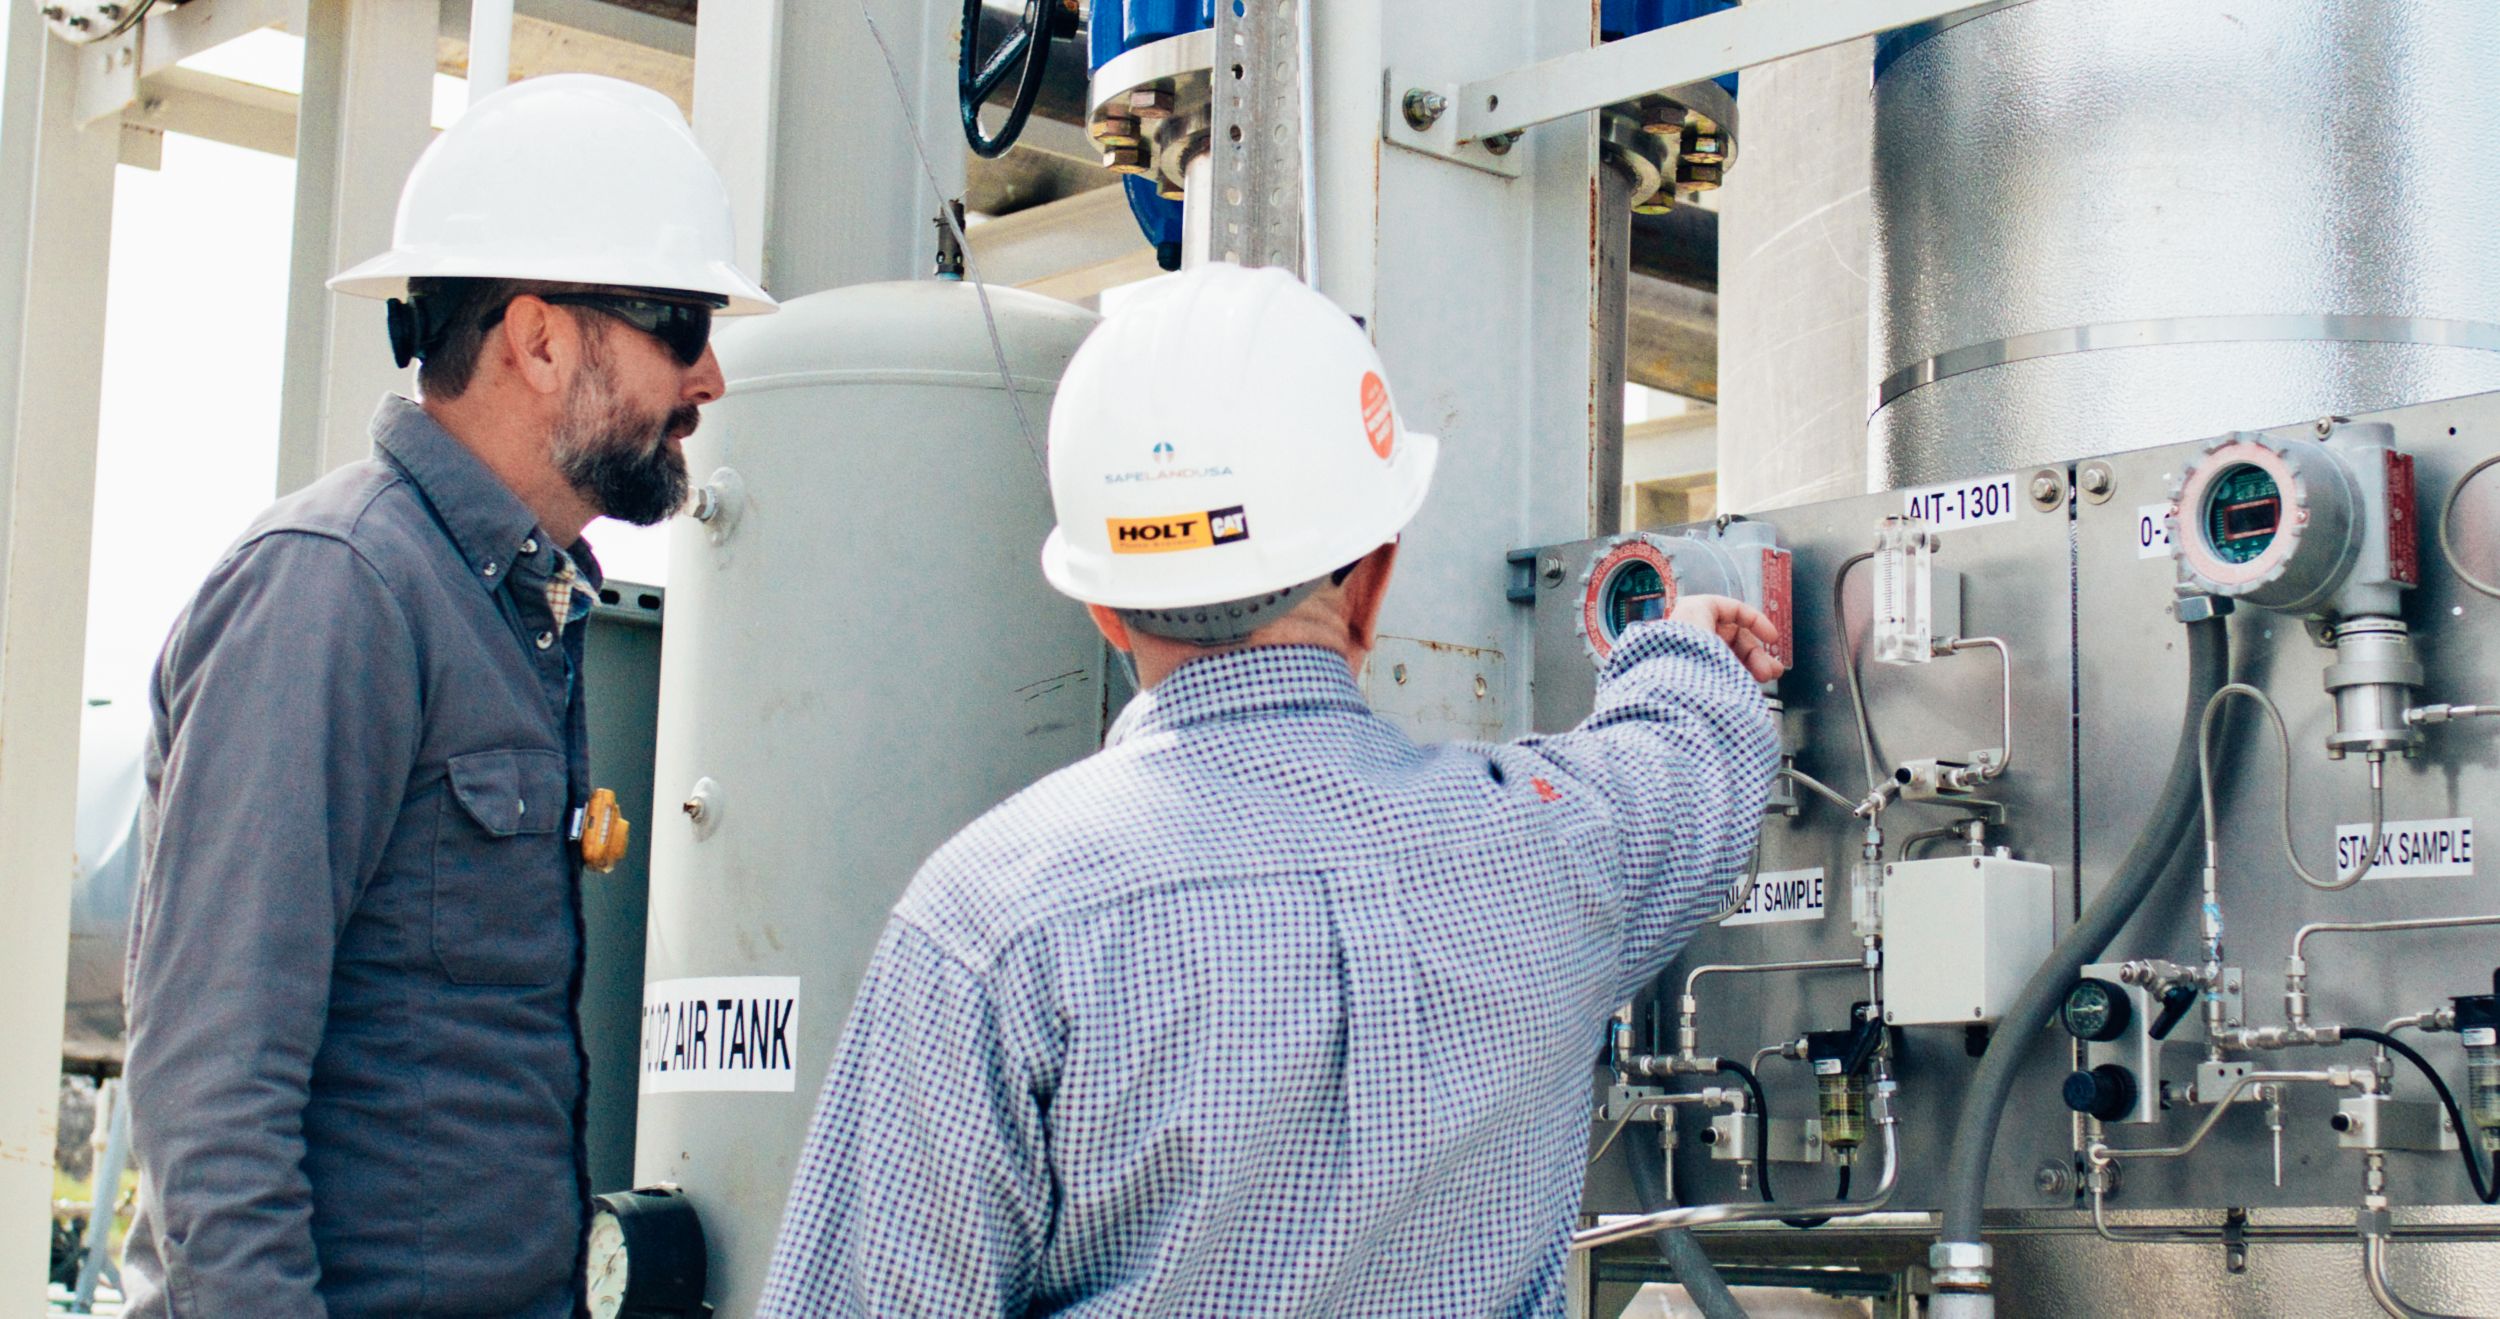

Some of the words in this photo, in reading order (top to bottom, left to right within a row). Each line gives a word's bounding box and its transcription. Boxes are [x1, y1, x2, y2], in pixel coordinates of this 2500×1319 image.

[1910, 481, 2011, 524] AIT-1301
[1119, 521, 1198, 541] HOLT
[1211, 512, 1244, 538] CAT
[2399, 829, 2471, 865] SAMPLE
[1764, 878, 1823, 912] SAMPLE
[673, 1000, 708, 1071] AIR
[717, 998, 794, 1070] TANK
